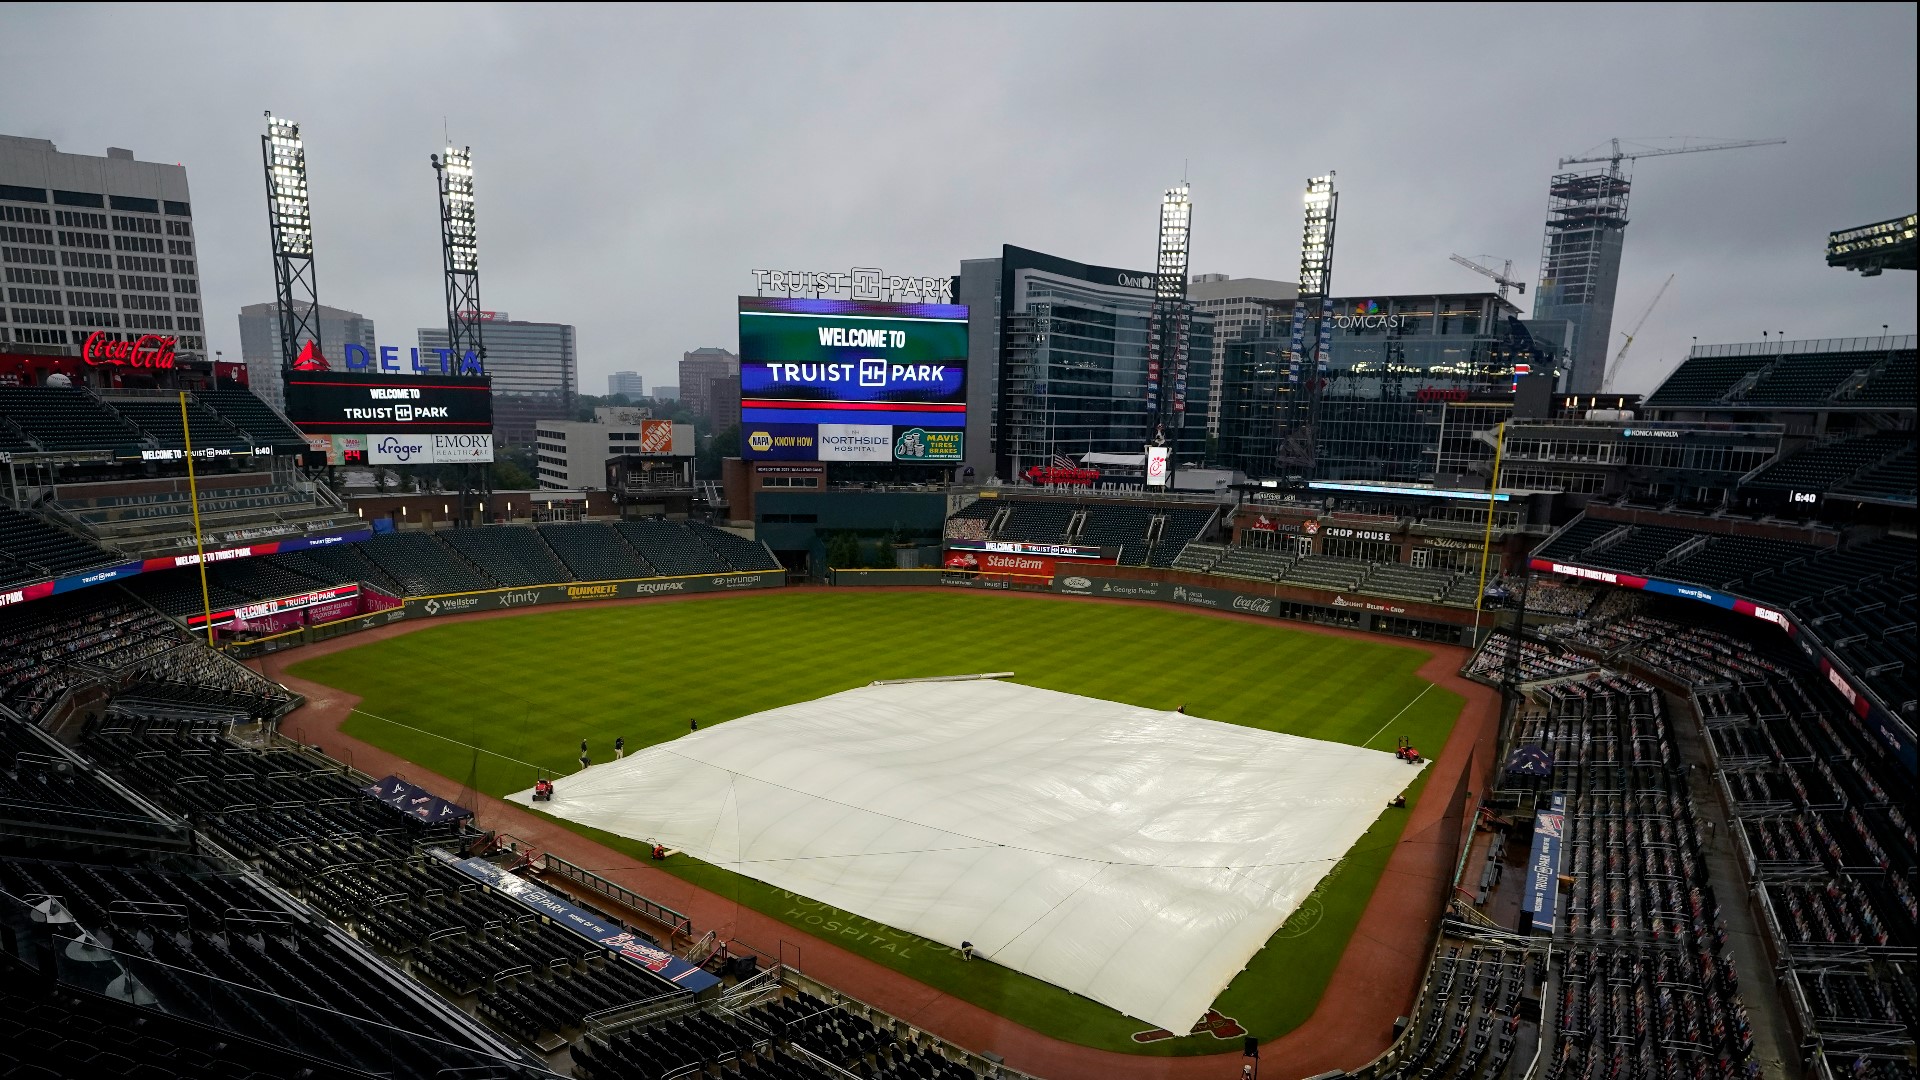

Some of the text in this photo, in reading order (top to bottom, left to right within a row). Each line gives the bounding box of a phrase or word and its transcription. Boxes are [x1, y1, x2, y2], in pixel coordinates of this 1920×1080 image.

[752, 269, 954, 298] TRUIST PARK
[818, 327, 906, 348] WELCOME TO
[344, 343, 483, 375] DELTA
[767, 363, 946, 382] TRUIST PARK
[369, 388, 420, 399] WELCOME TO
[344, 406, 449, 419] TRUIST PARK
[926, 434, 960, 442] MAVIS
[1653, 430, 1678, 438] MINOLTA
[435, 434, 490, 448] EMORY
[752, 436, 769, 446] NAPA
[774, 436, 813, 447] KNOW HOW
[822, 436, 889, 446] NORTHSIDE
[142, 450, 173, 460] WELCOME
[172, 450, 182, 459] TO
[184, 449, 206, 458] TUIST
[254, 446, 271, 455] 6:40
[377, 436, 423, 462] Kroger
[344, 450, 361, 461] 24
[1794, 492, 1816, 503] 6:40
[1278, 523, 1301, 533] LIGHT
[1326, 528, 1391, 541] CHOP HOUSE
[985, 541, 1013, 551] WELCOME
[1013, 543, 1022, 552] TO
[1028, 545, 1051, 553] TRUIST
[1434, 537, 1467, 549] Silver
[207, 552, 215, 561] TO
[215, 550, 235, 560] TRUIST
[234, 547, 251, 557] PARK
[726, 575, 761, 584] HYUNDAI
[567, 584, 618, 596] QUIKRETE
[637, 581, 685, 593] EQUIFAX
[1113, 585, 1137, 595] Georgia
[442, 598, 479, 607] Wellstar
[499, 589, 540, 607] xfinity
[234, 590, 336, 619] WELCOME TO TRUIST PARK
[537, 895, 569, 915] PARK
[785, 908, 912, 959] HOSPITAL
